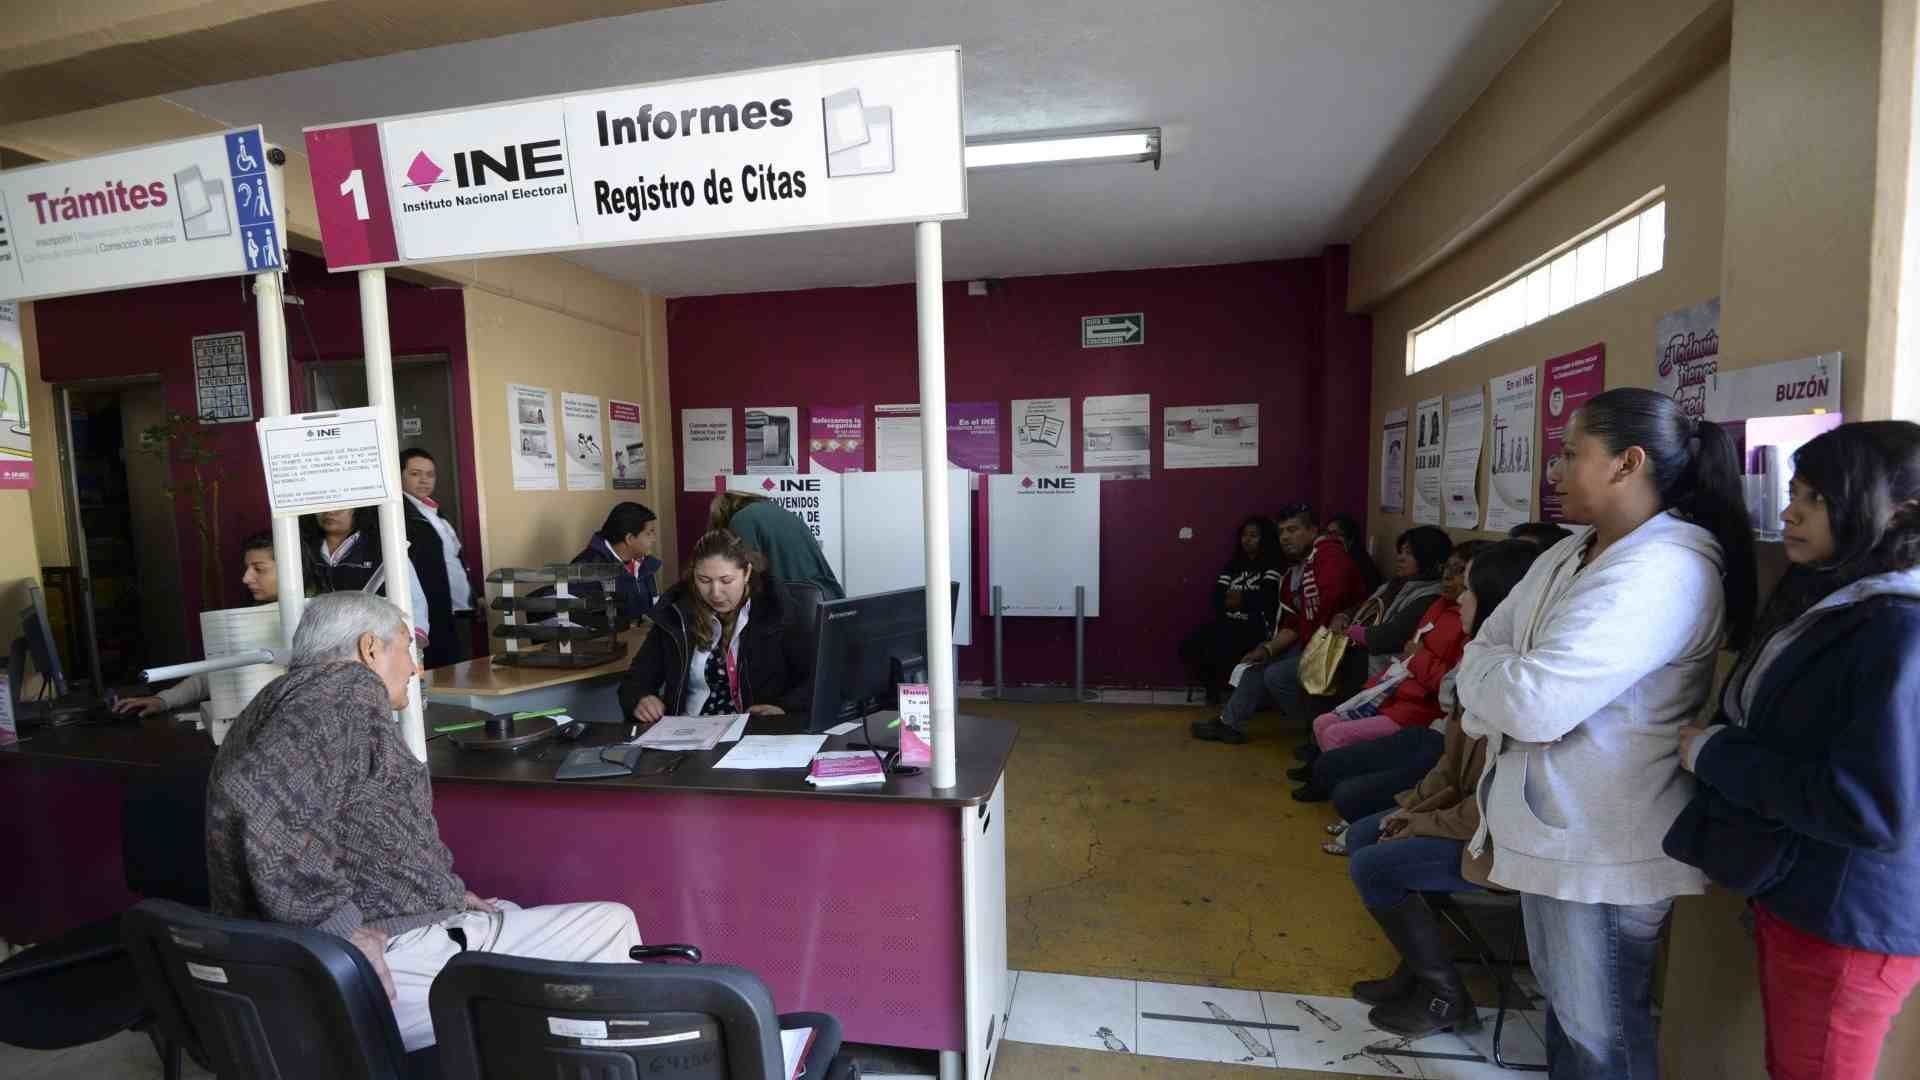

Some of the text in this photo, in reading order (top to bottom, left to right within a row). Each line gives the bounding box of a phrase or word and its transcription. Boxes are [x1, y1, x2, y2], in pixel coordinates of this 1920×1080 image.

[596, 98, 793, 147] Informes
[453, 139, 565, 189] INE
[27, 179, 169, 225] Trámites
[339, 168, 371, 222] 1
[403, 183, 568, 213] Instituto Nacional Electoral
[594, 163, 807, 222] Registro de Citas
[1522, 373, 1535, 385] INE
[1775, 374, 1829, 402] BUZÓN
[316, 427, 341, 438] INE
[779, 479, 821, 492] INE
[1037, 477, 1076, 489] INE
[807, 511, 820, 522] DE
